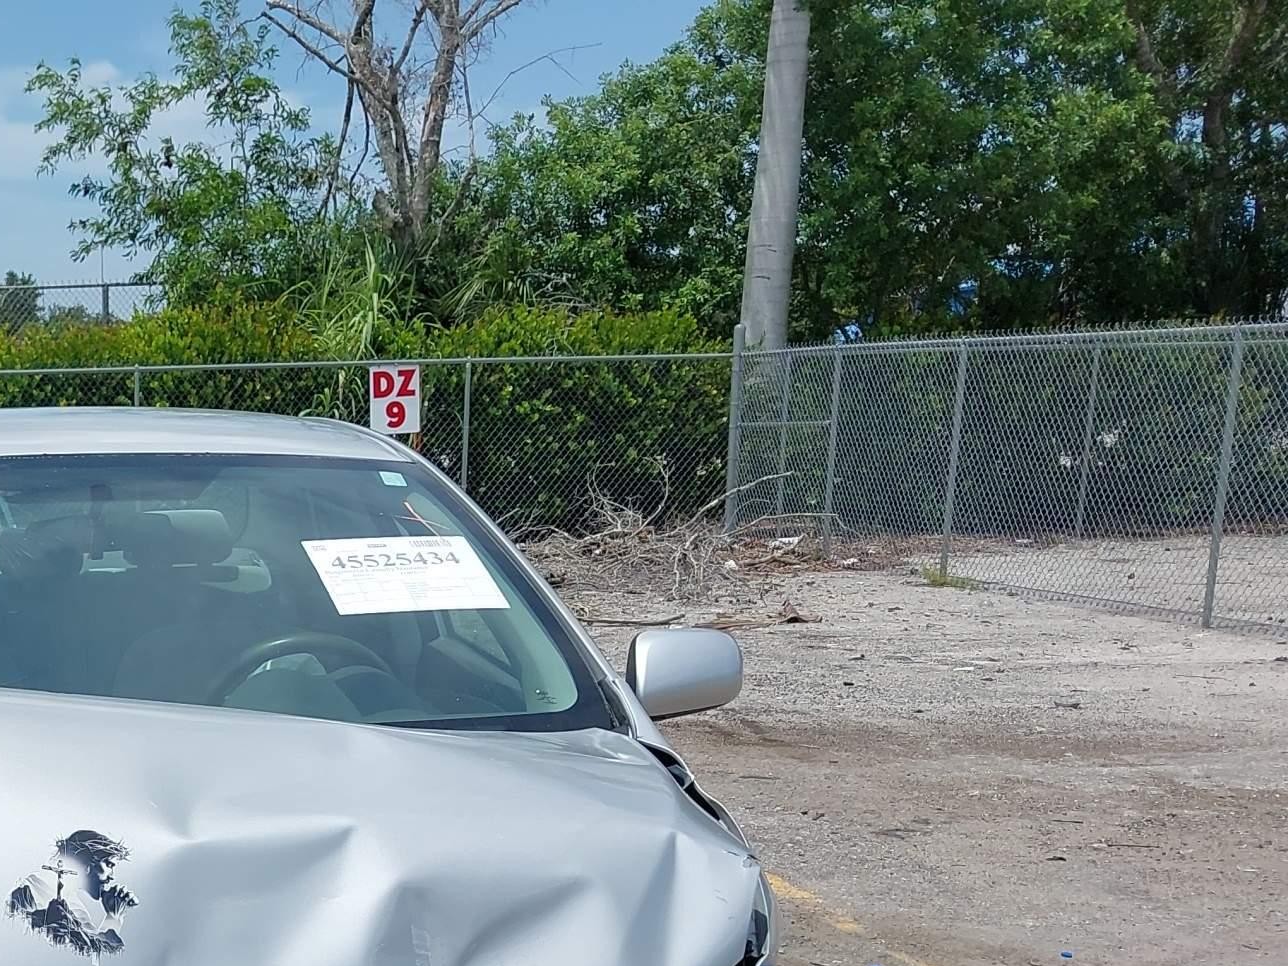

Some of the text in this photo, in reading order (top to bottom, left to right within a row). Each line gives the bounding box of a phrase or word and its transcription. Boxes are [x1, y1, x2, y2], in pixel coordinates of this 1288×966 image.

[373, 369, 416, 399] DZ
[385, 400, 406, 429] 9
[331, 551, 461, 569] 45525434
